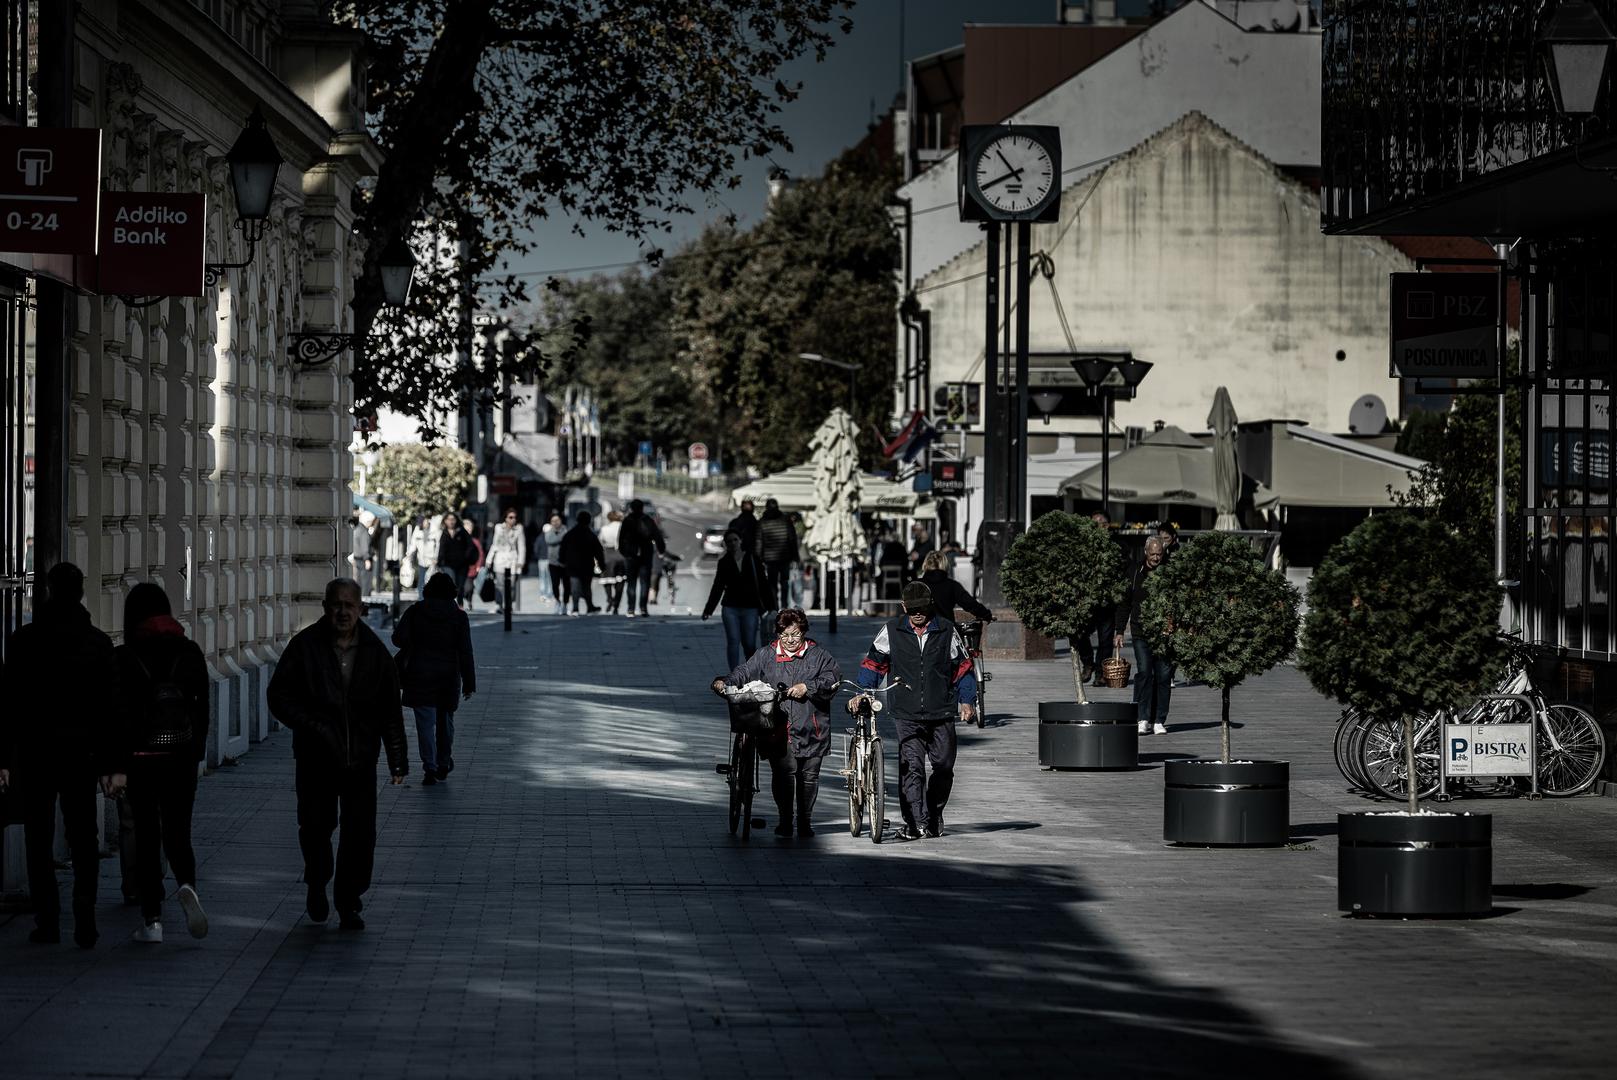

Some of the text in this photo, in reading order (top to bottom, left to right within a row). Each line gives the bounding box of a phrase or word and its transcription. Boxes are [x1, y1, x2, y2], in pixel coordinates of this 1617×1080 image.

[6, 211, 60, 232] 0-24
[114, 205, 189, 225] Addiko
[113, 226, 168, 245] Bank
[1443, 294, 1489, 317] PBZ
[1404, 347, 1488, 367] POSLOVNICA
[1451, 738, 1468, 761] P
[1474, 742, 1528, 757] BISTRA
